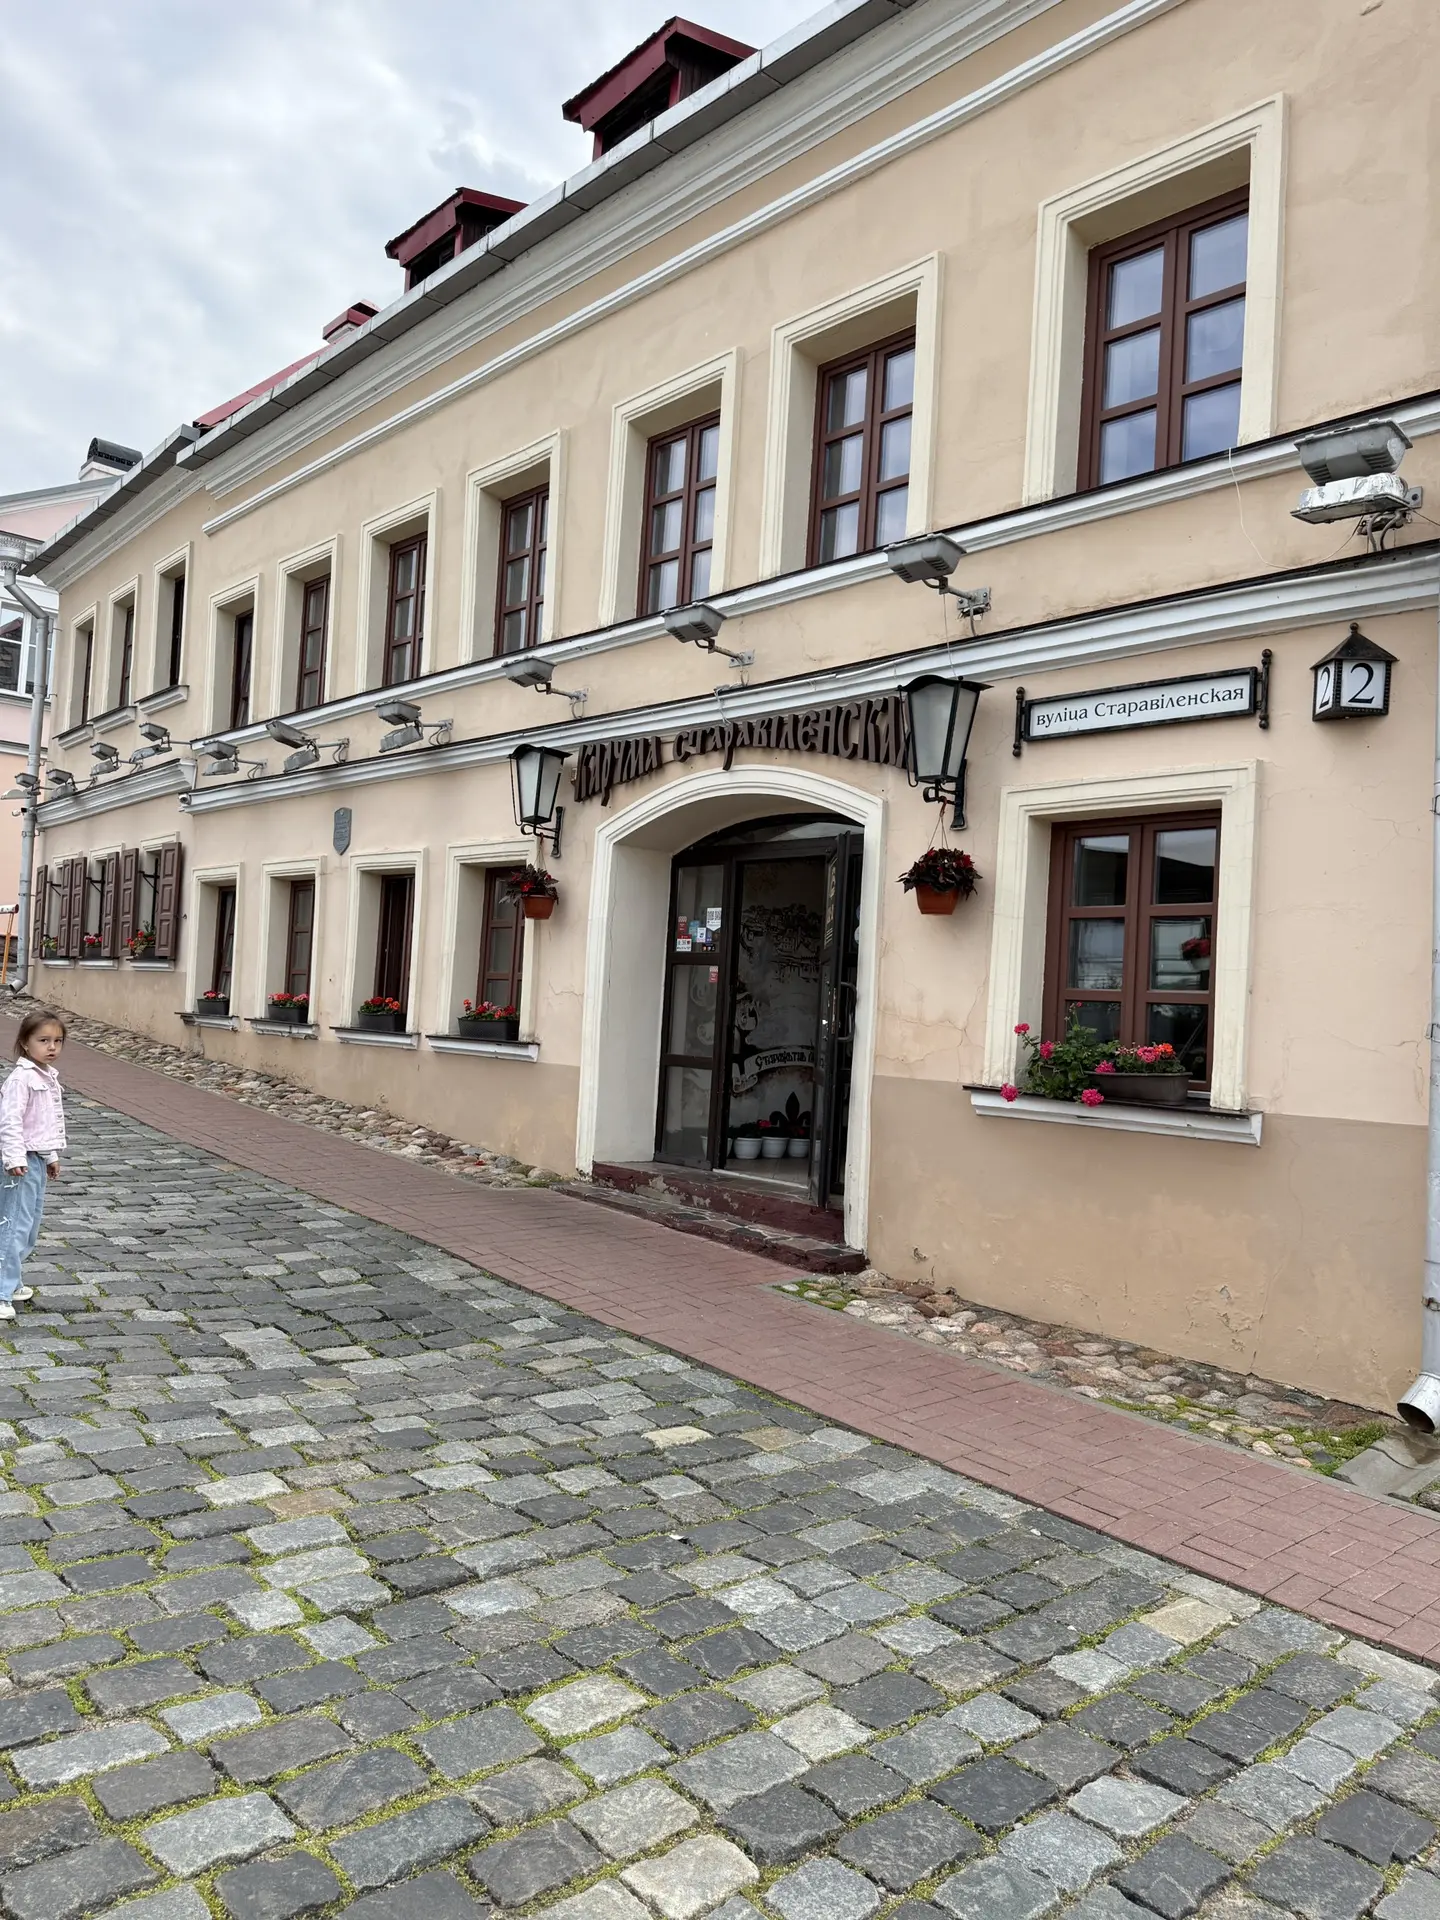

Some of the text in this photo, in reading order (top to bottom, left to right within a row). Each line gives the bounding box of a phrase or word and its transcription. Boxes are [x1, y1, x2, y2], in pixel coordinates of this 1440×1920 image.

[1319, 666, 1331, 709] 2
[1347, 662, 1375, 704] 2
[1036, 687, 1245, 728] вуліца Старавіленская
